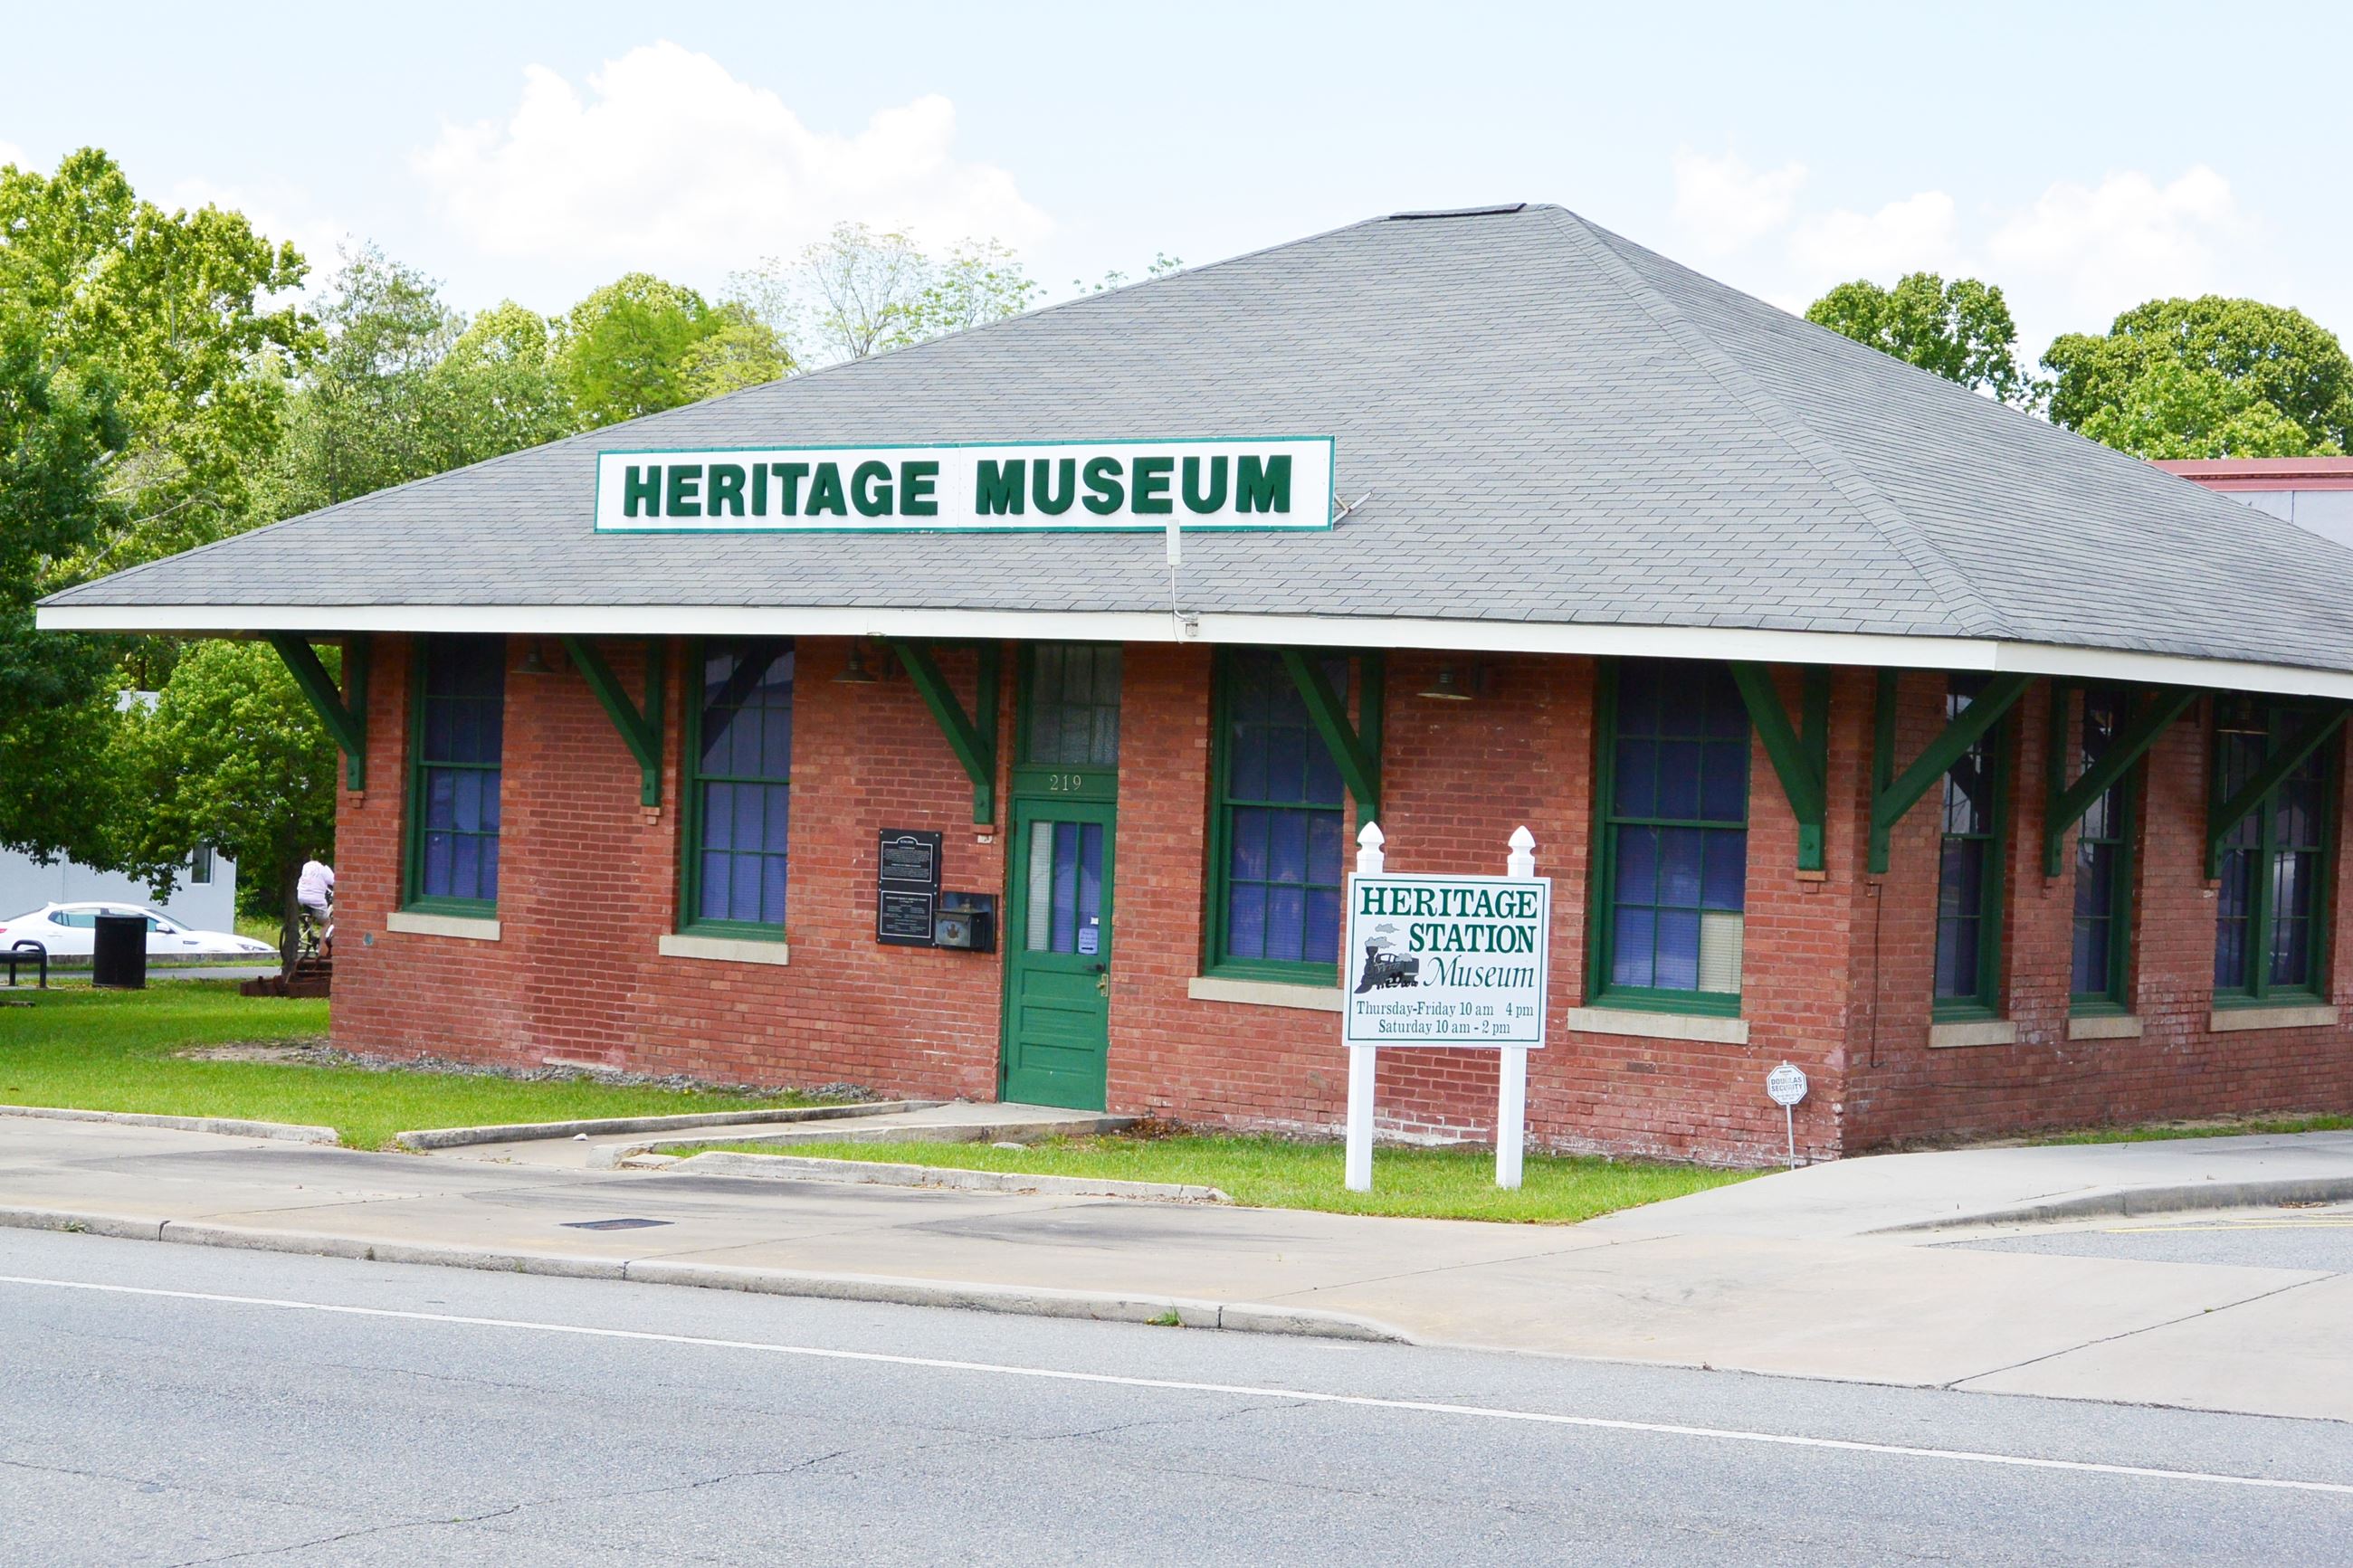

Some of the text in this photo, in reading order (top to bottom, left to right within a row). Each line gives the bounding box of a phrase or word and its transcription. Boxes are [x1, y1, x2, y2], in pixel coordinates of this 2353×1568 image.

[624, 454, 1292, 518] HERITAGE MUSEUM
[1049, 774, 1082, 792] 219
[1360, 887, 1538, 918] HERITAGE
[1408, 923, 1537, 954] STATION
[1423, 955, 1535, 988] Museum
[1357, 1001, 1533, 1018] Thursday-Friday 10 am 4 pm
[1378, 1019, 1432, 1035] Saturday
[1435, 1020, 1448, 1033] 10
[1452, 1023, 1470, 1033] am
[1482, 1021, 1490, 1033] 2
[1492, 1023, 1510, 1035] pm
